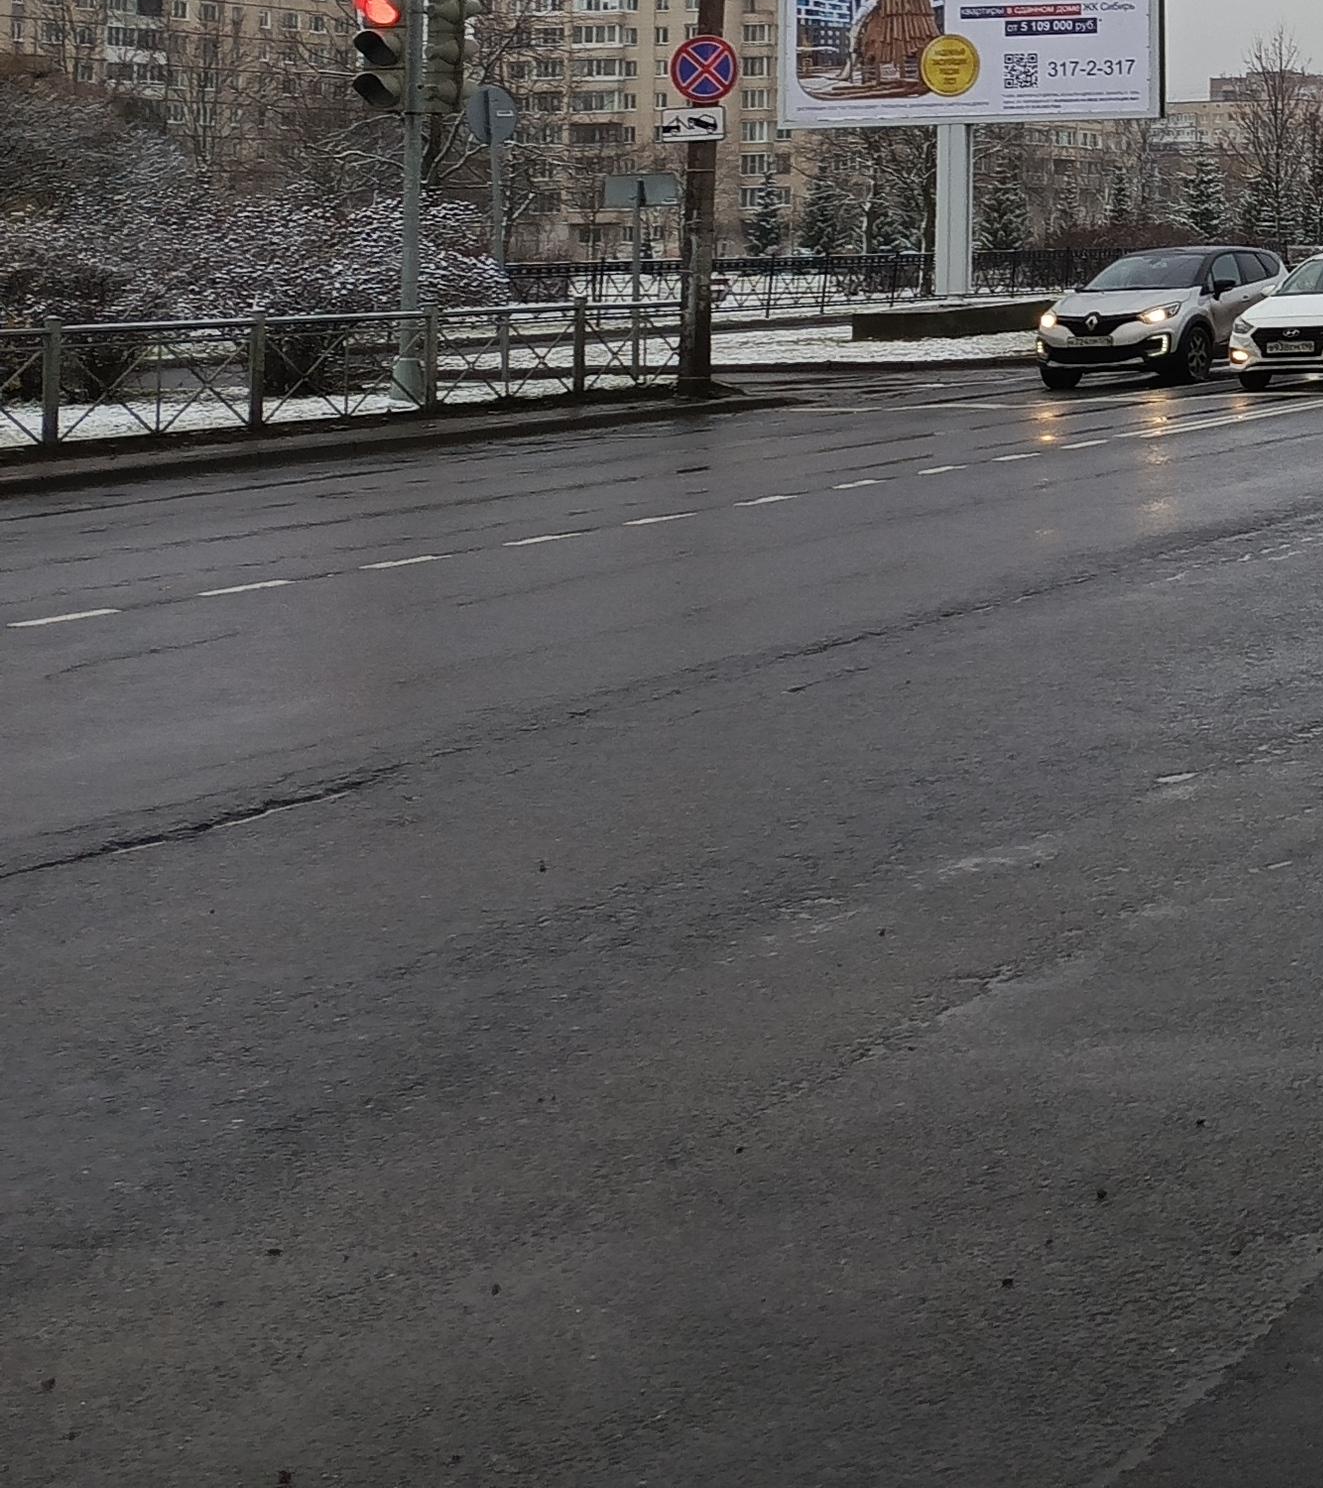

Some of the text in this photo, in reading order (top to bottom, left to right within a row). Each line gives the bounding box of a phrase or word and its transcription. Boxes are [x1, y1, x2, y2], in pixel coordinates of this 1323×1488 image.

[1020, 22, 1028, 31] 5
[1031, 21, 1050, 31] 109
[1053, 20, 1073, 30] 000
[1047, 59, 1136, 77] 317-2-317
